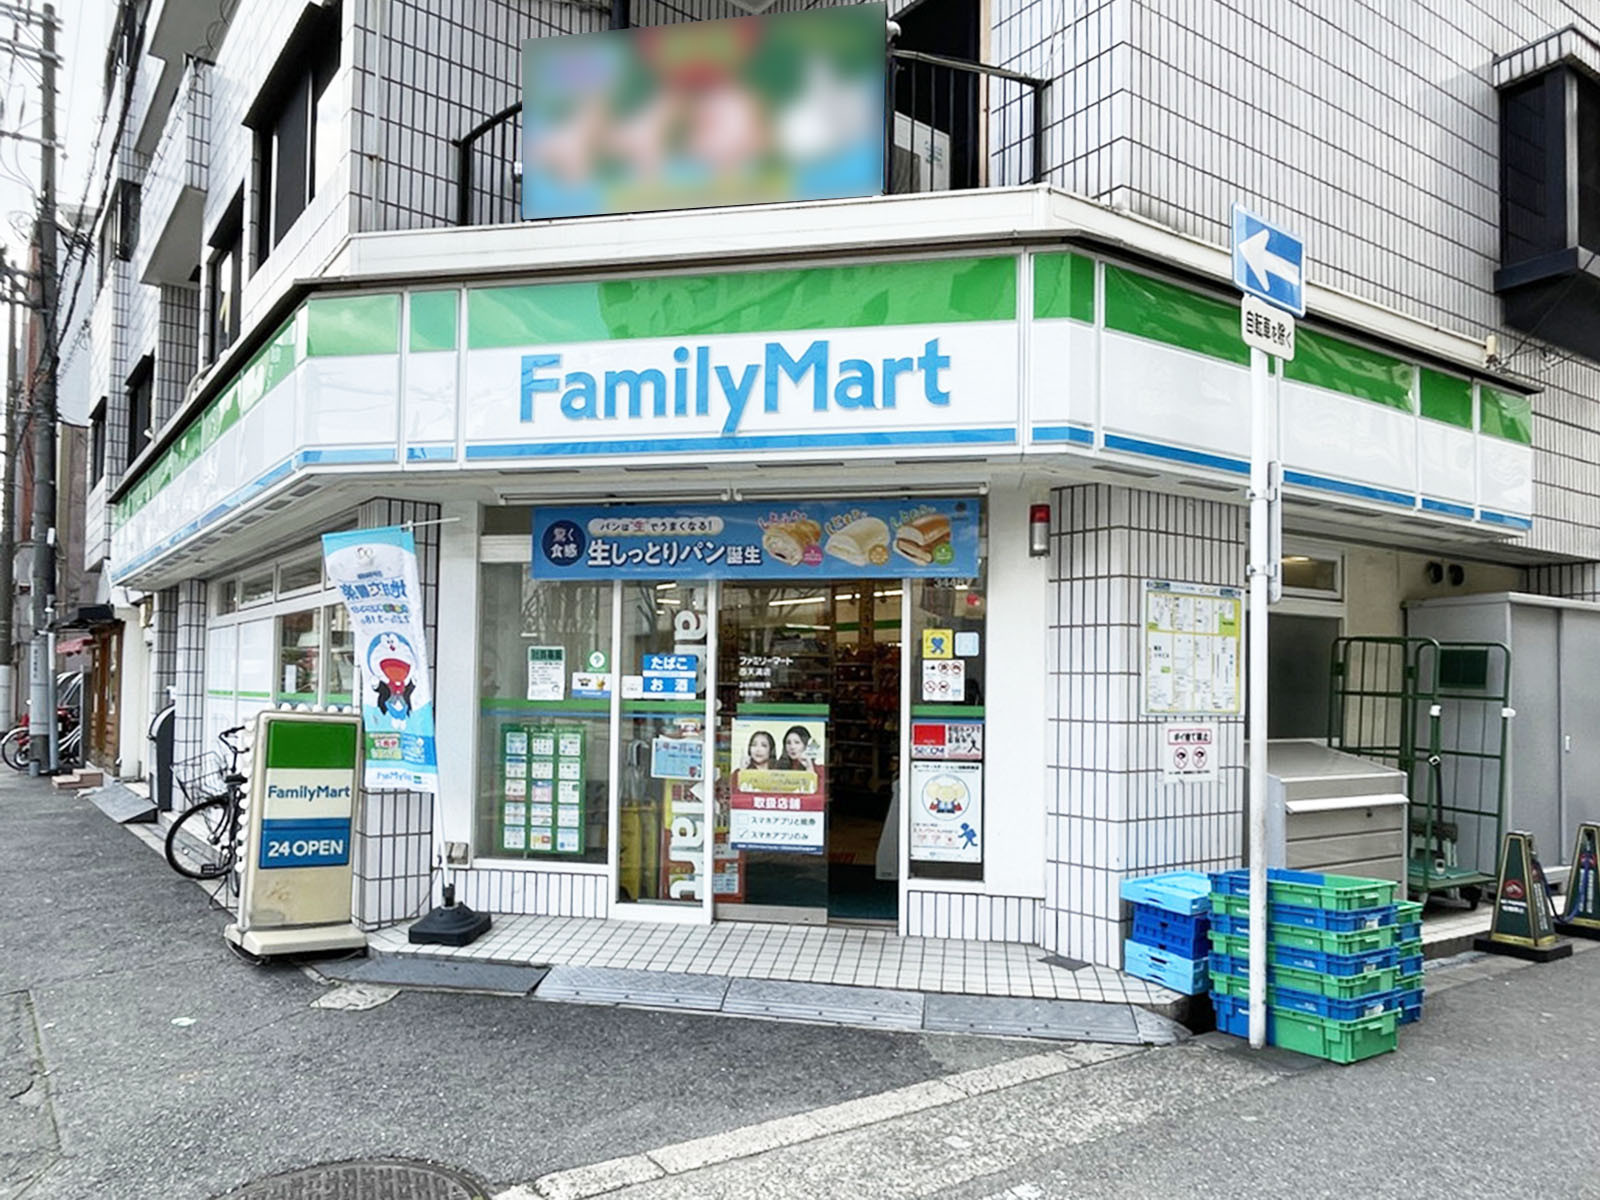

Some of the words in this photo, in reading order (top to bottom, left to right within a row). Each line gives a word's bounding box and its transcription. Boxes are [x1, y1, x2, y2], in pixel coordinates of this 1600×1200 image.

[1246, 311, 1291, 349] 自転車を除く
[520, 338, 950, 437] FamilyMart
[587, 539, 762, 567] 生しっとりパン誕生
[651, 657, 688, 670] たばこ
[739, 656, 793, 666] ファミリーマート
[268, 785, 351, 802] FamilyMart
[268, 841, 290, 857] 24
[292, 839, 344, 856] OPEN
